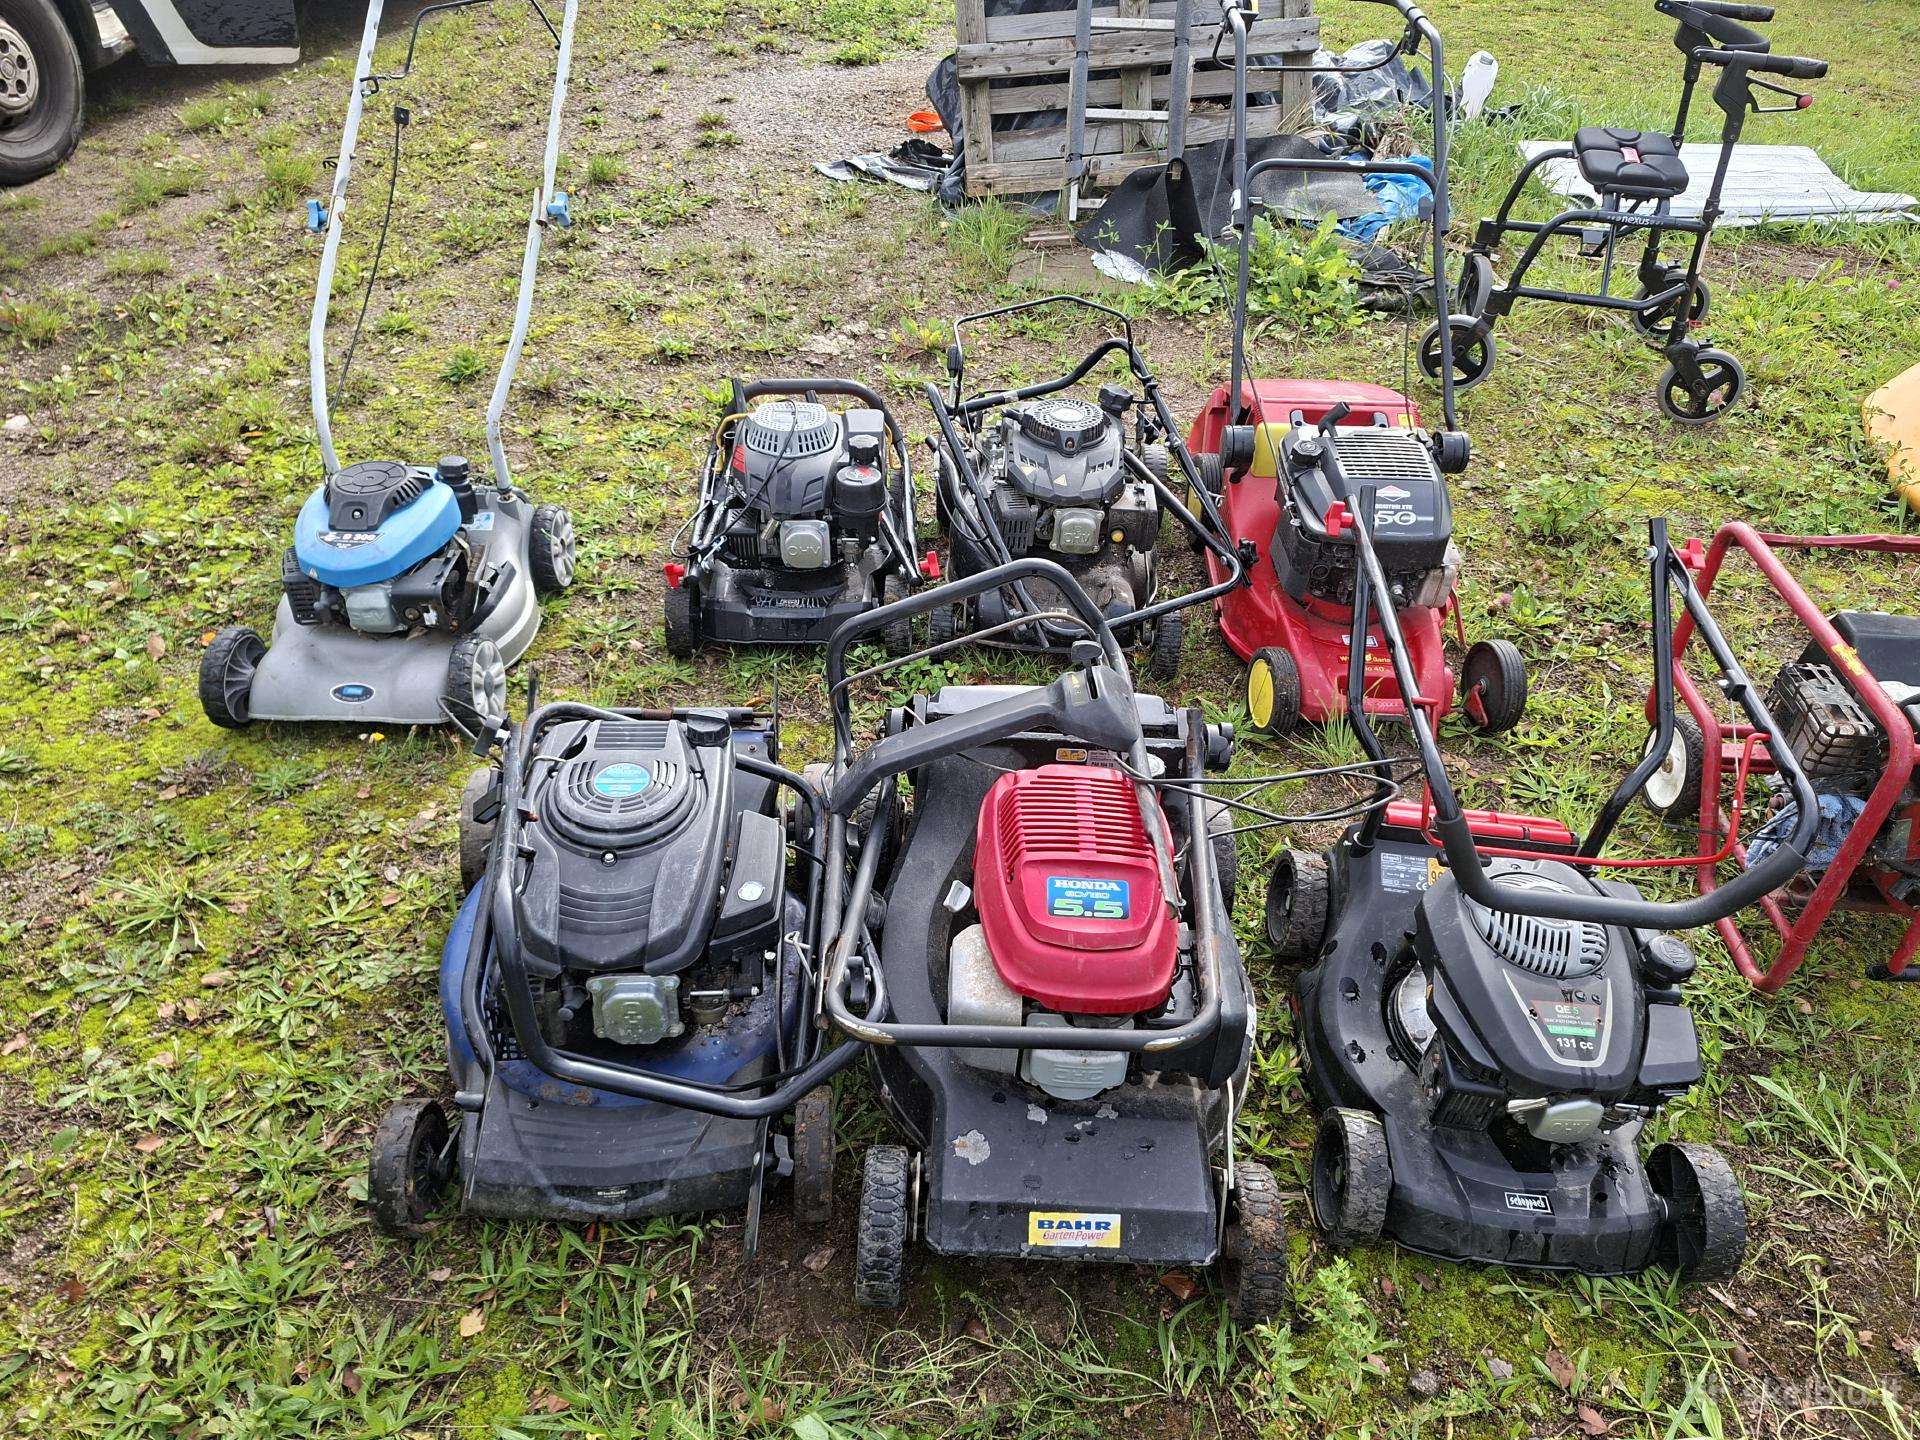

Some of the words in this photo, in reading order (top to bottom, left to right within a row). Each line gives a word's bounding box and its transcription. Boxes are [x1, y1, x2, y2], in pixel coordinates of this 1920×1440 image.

[1621, 215, 1650, 225] nexus
[1054, 879, 1122, 891] HONDA
[1053, 898, 1124, 918] 5.5
[1555, 1004, 1571, 1014] QE
[1556, 1037, 1577, 1048] 131
[1579, 1041, 1594, 1050] cc
[1037, 1219, 1112, 1231] BAHR
